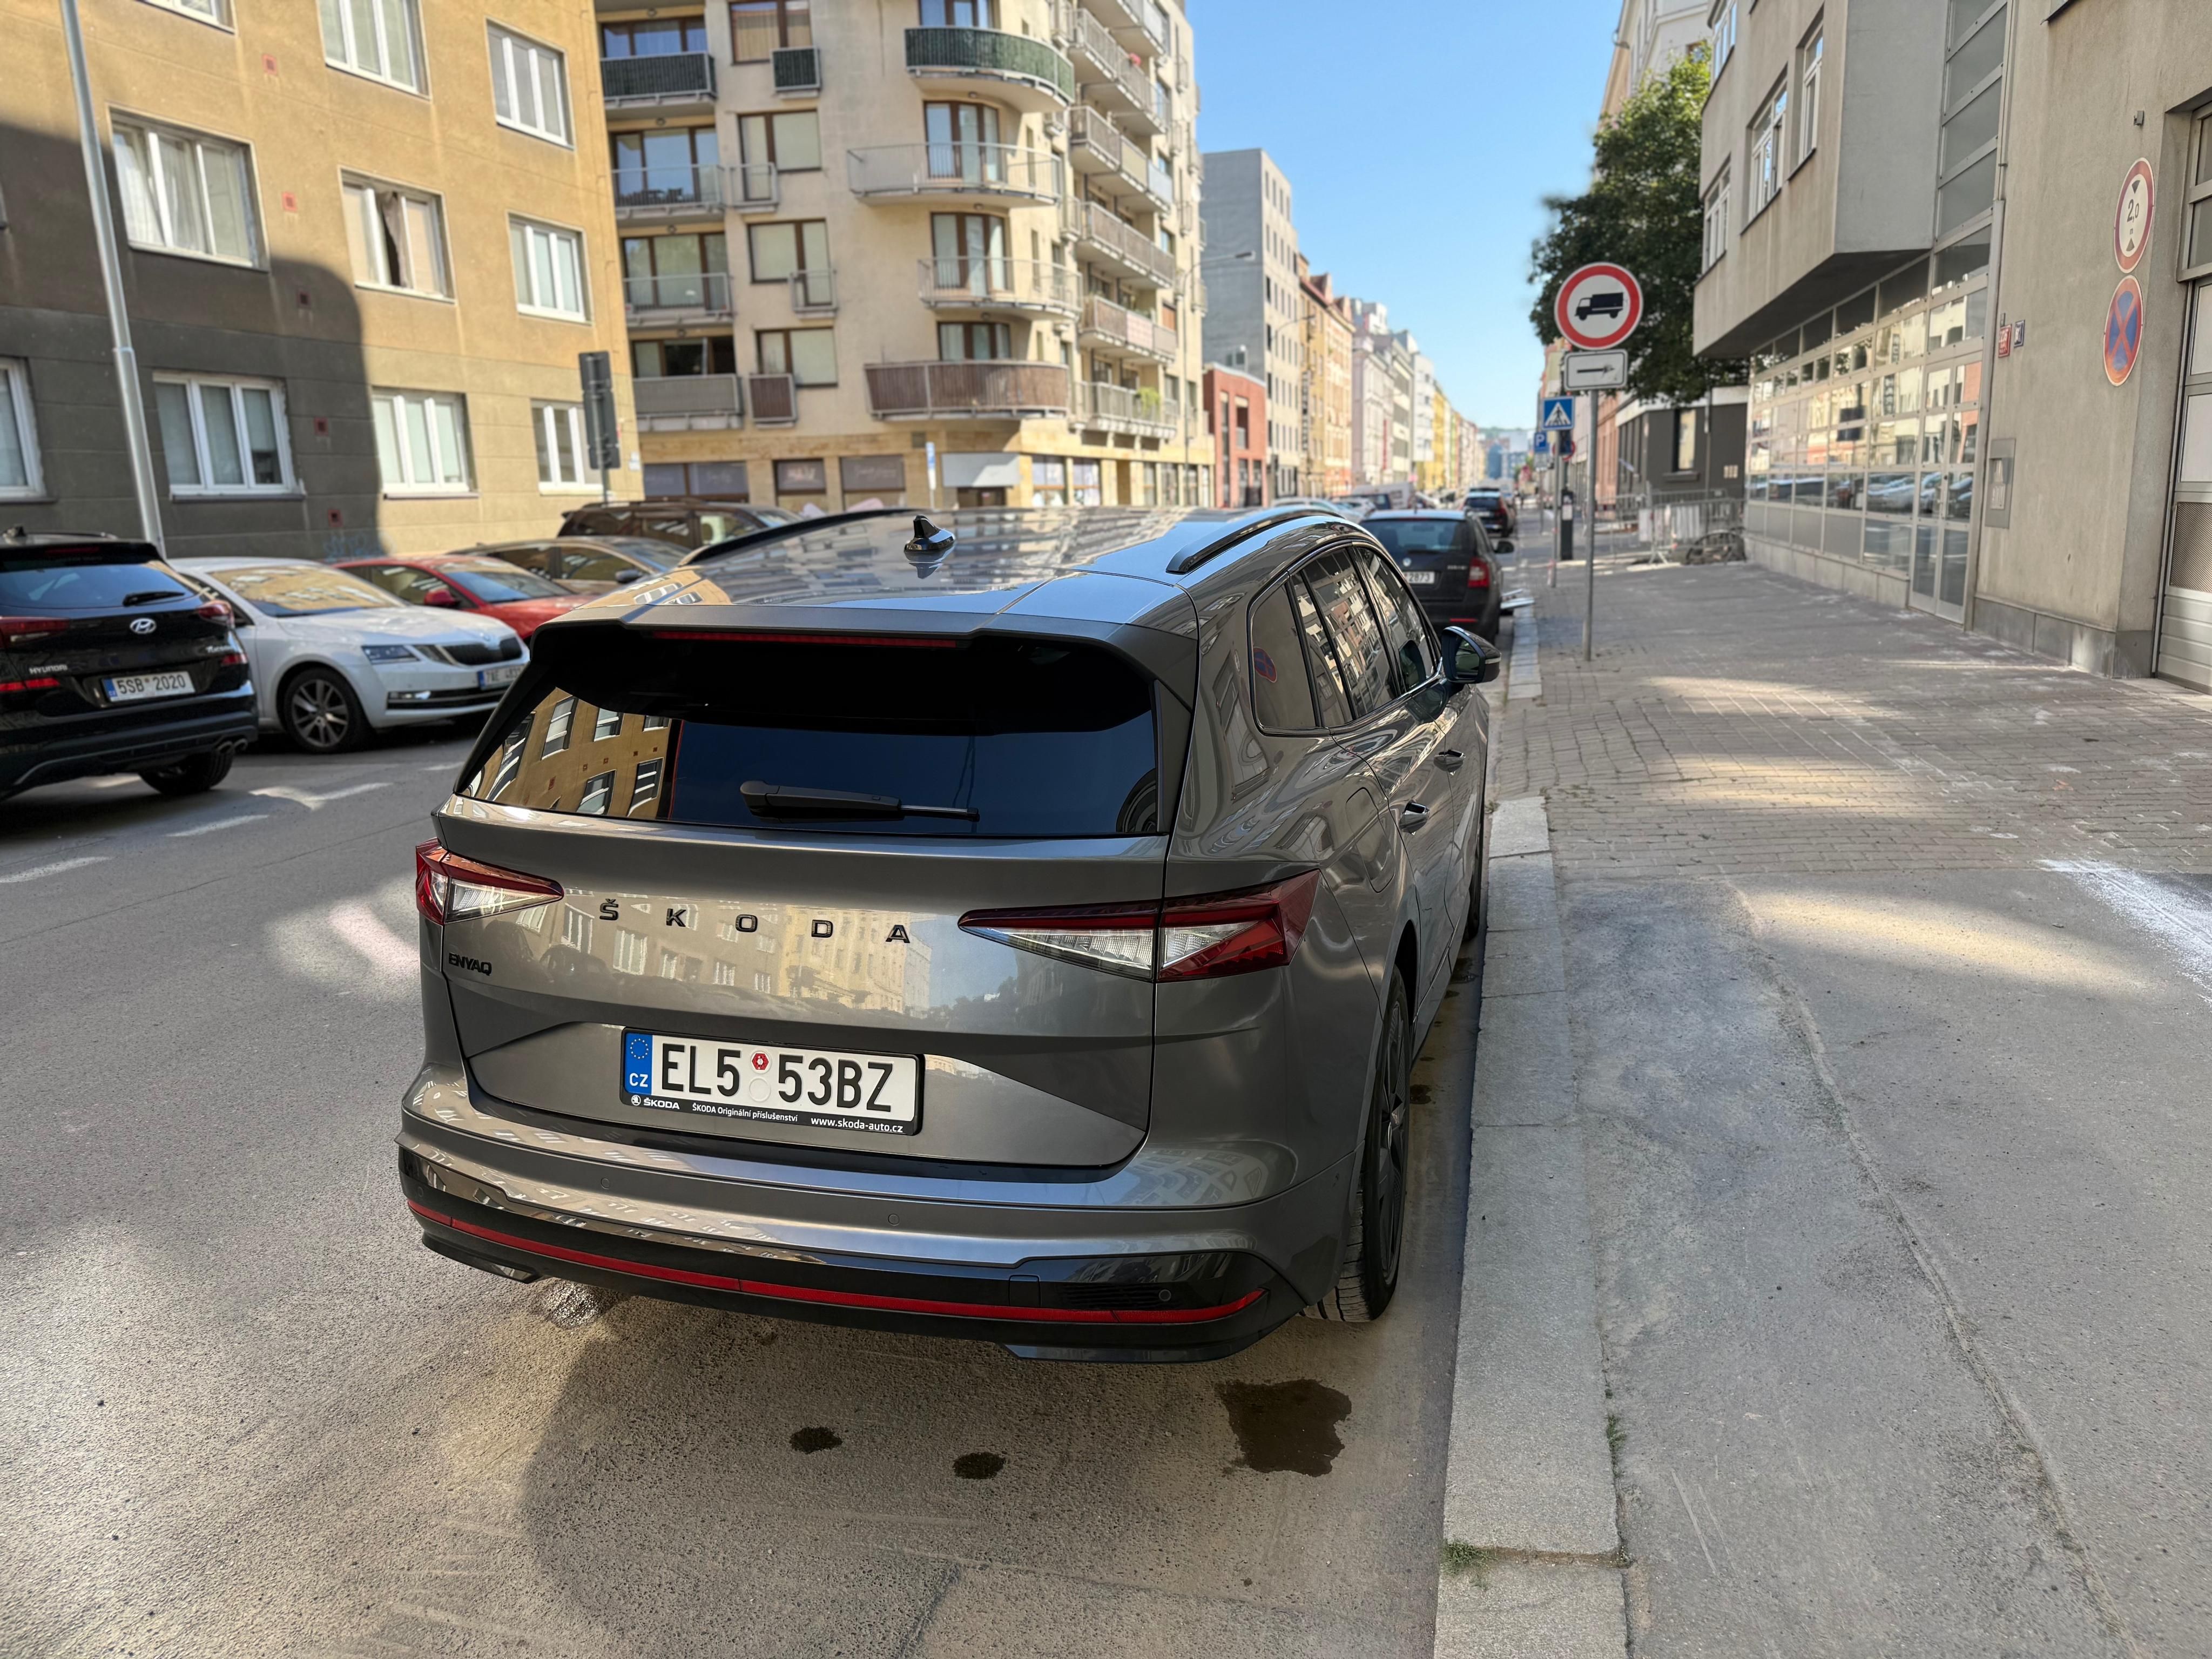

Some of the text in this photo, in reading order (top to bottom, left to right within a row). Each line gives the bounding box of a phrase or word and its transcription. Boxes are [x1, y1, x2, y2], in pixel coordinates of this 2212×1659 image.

[2127, 199, 2140, 222] 2,0
[1535, 434, 1545, 447] P
[116, 675, 186, 694] 5SB 2020
[599, 899, 911, 943] ŠKODA
[449, 952, 492, 976] ENYAQ
[629, 1073, 648, 1087] CZ
[662, 1043, 893, 1112] EL5 53BZ
[644, 1097, 680, 1109] ŠKODA
[692, 1103, 798, 1122] ŠKODA Originální příslušenství
[811, 1118, 903, 1132] www.skoda-auto.cz
